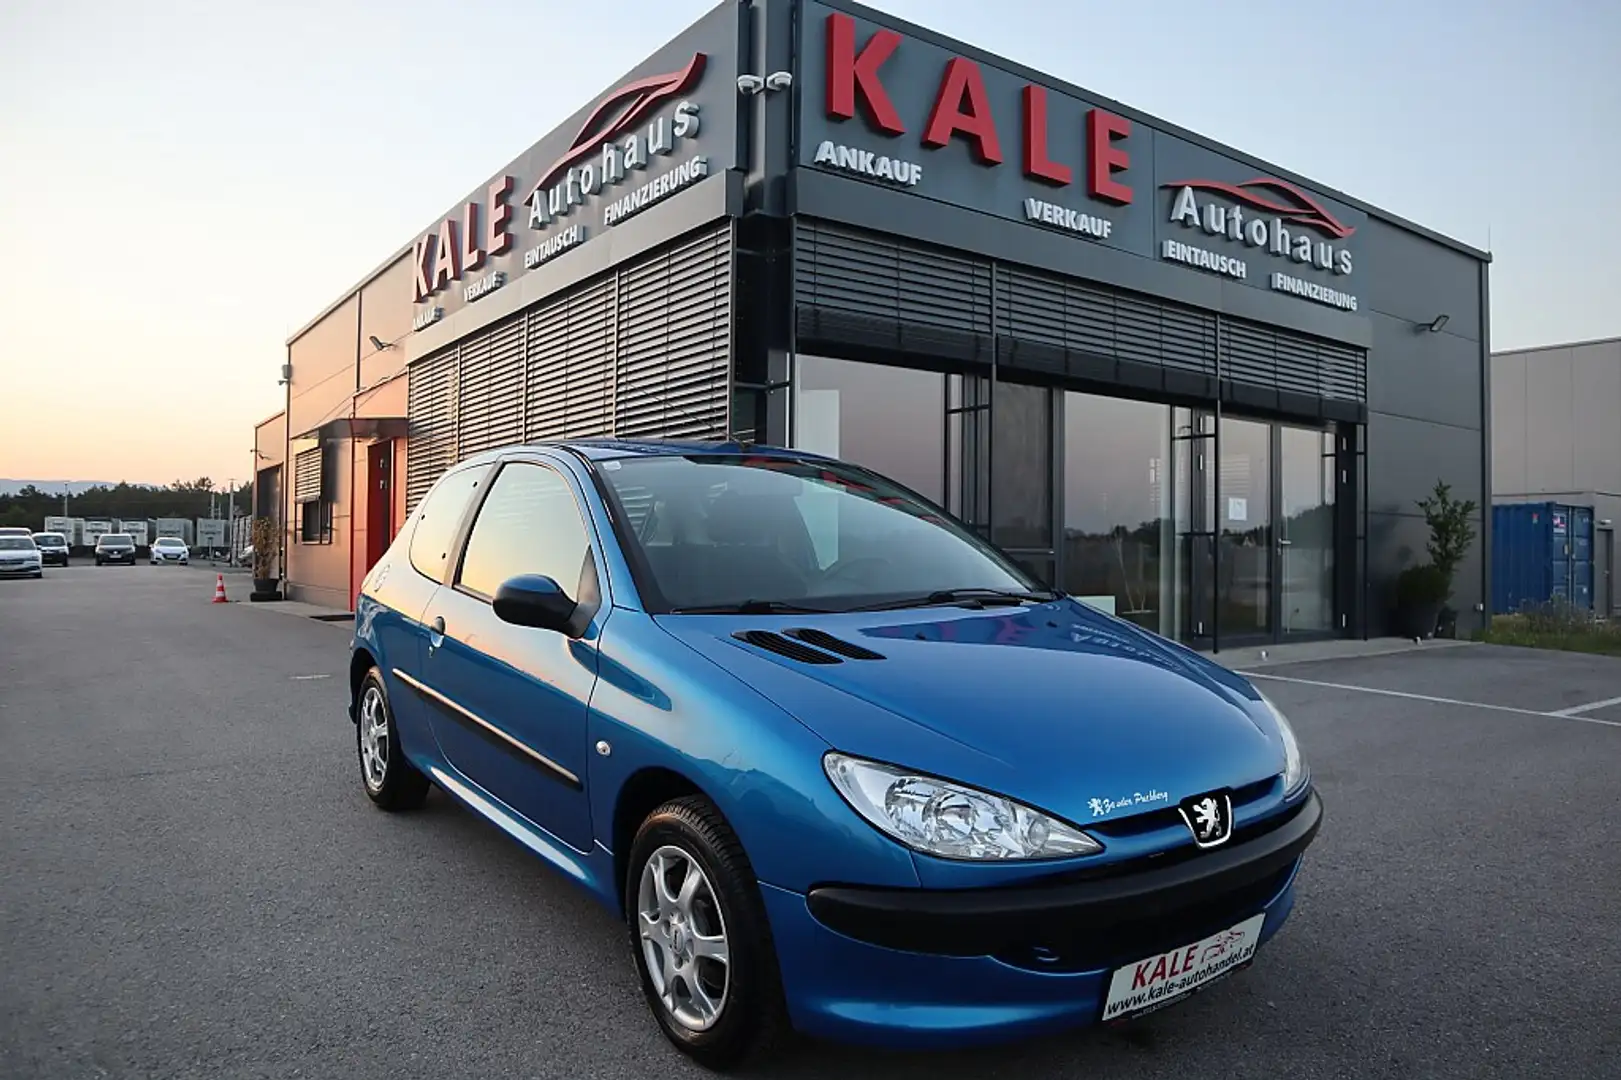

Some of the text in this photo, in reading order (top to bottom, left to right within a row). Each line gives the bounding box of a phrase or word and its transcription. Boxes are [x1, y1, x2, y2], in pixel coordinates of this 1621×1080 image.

[412, 101, 700, 304] KALE Autohaus
[524, 224, 586, 270] EINTAUSCH
[603, 155, 708, 227] FINANZIERUNG
[826, 12, 1353, 275] KALE Autohaus
[814, 140, 1358, 312] ANKAUF VERKAUF EINTAUSCH FINANZIERUNG
[1106, 943, 1255, 1015] www.kale-autohandel.at
[1131, 944, 1200, 991] KALE
